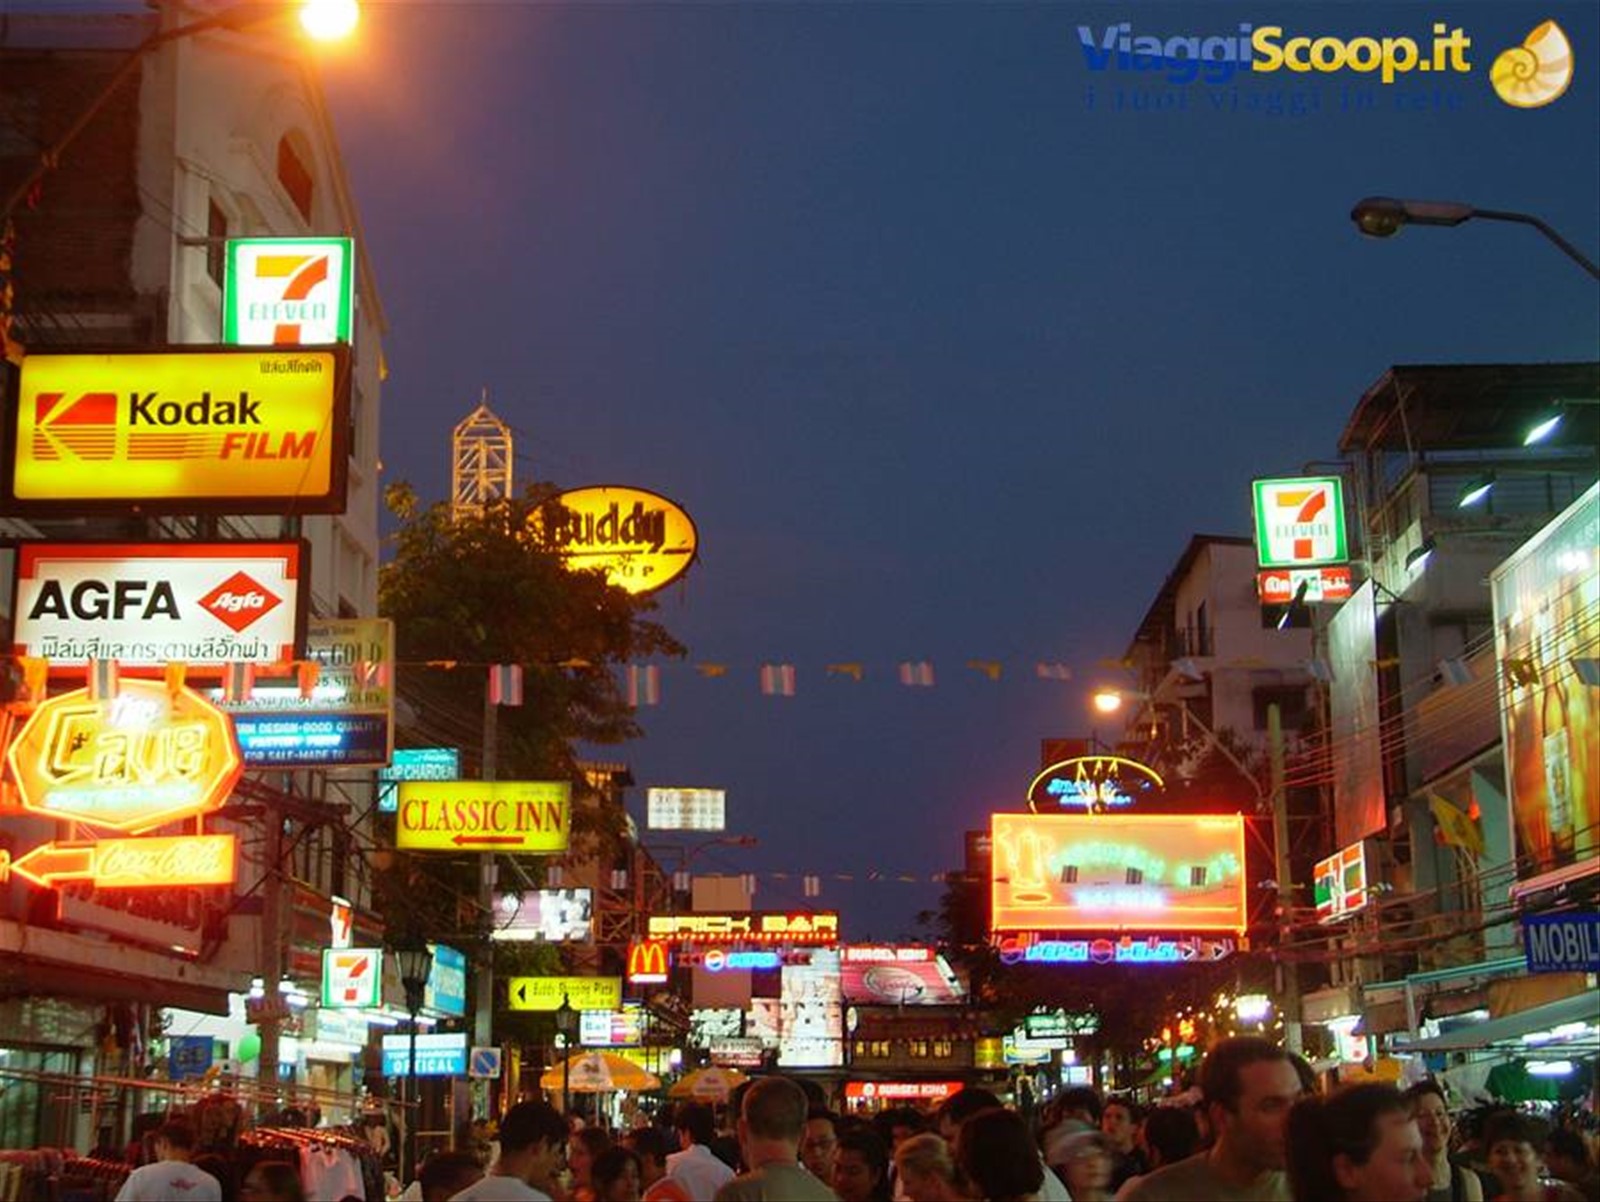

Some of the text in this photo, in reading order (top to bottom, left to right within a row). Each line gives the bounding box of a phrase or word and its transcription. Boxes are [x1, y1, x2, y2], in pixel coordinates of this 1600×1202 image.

[129, 392, 261, 426] Kodak
[219, 431, 318, 460] FILM
[1276, 489, 1326, 559] 7
[28, 580, 181, 621] AGFA
[211, 591, 265, 613] Agfa
[401, 799, 564, 832] CLASSIC INN
[649, 915, 838, 933] BRICK BAR
[1529, 922, 1600, 964] MOBIL
